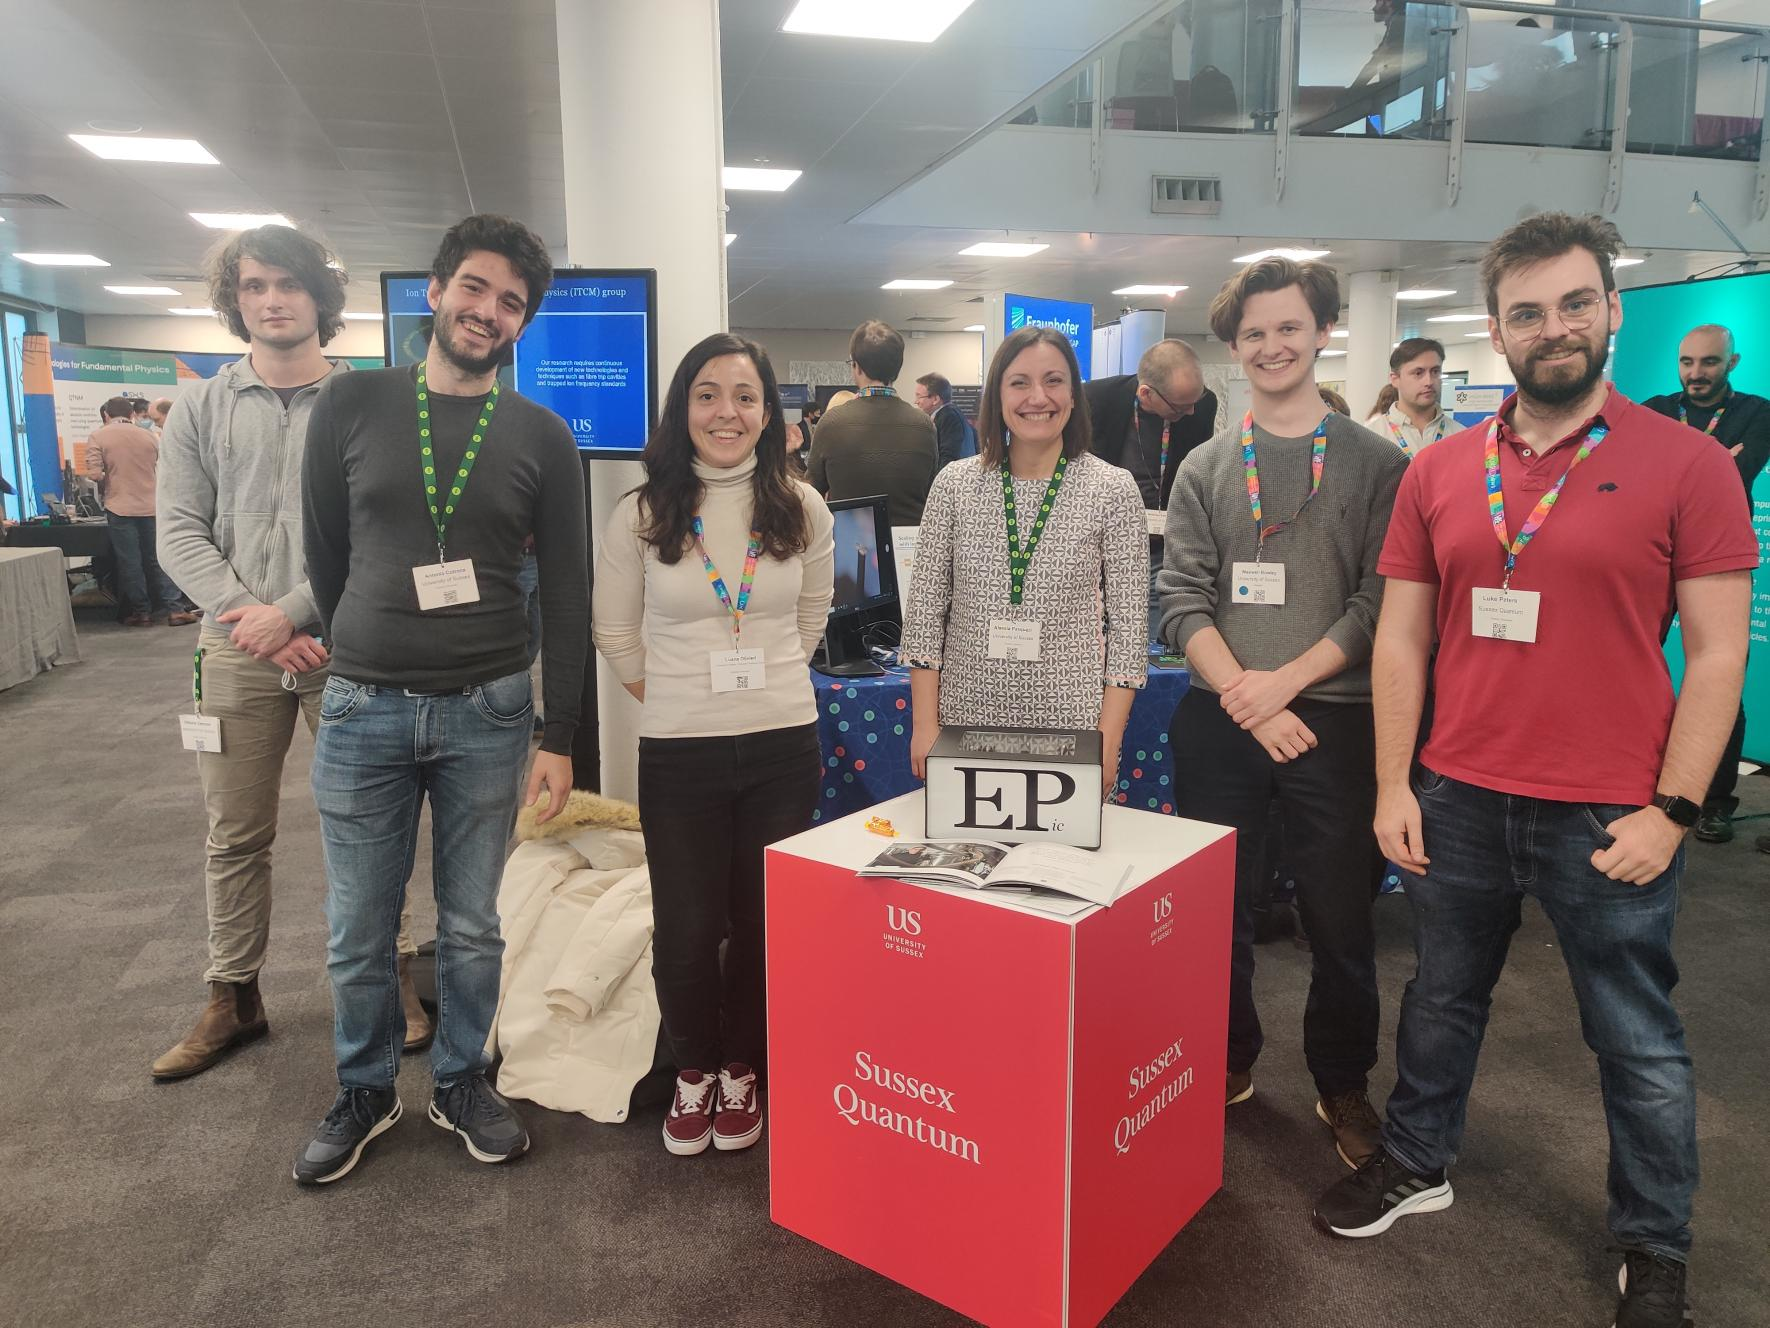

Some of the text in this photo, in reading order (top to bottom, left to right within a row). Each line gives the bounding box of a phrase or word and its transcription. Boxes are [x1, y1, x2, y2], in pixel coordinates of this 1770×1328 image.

[406, 288, 420, 297] Ion
[570, 287, 600, 298] (ITCM)
[602, 288, 627, 299] group
[1026, 315, 1080, 336] Fraunhofer
[71, 361, 81, 369] for
[81, 362, 133, 372] Fundamental
[135, 364, 170, 374] Physics
[572, 418, 592, 432] US
[1152, 891, 1173, 924] US
[885, 904, 922, 935] US
[1150, 919, 1174, 939] UNIVERSITY
[883, 933, 927, 951] UNIVERSITY
[1151, 928, 1173, 946] OF SUSSEX
[885, 941, 924, 959] OF SUSSEX
[1128, 1037, 1184, 1100] Sussex
[855, 1051, 957, 1114] Sussex
[1114, 1065, 1194, 1157] Quantum
[833, 1083, 982, 1165] Quantum
